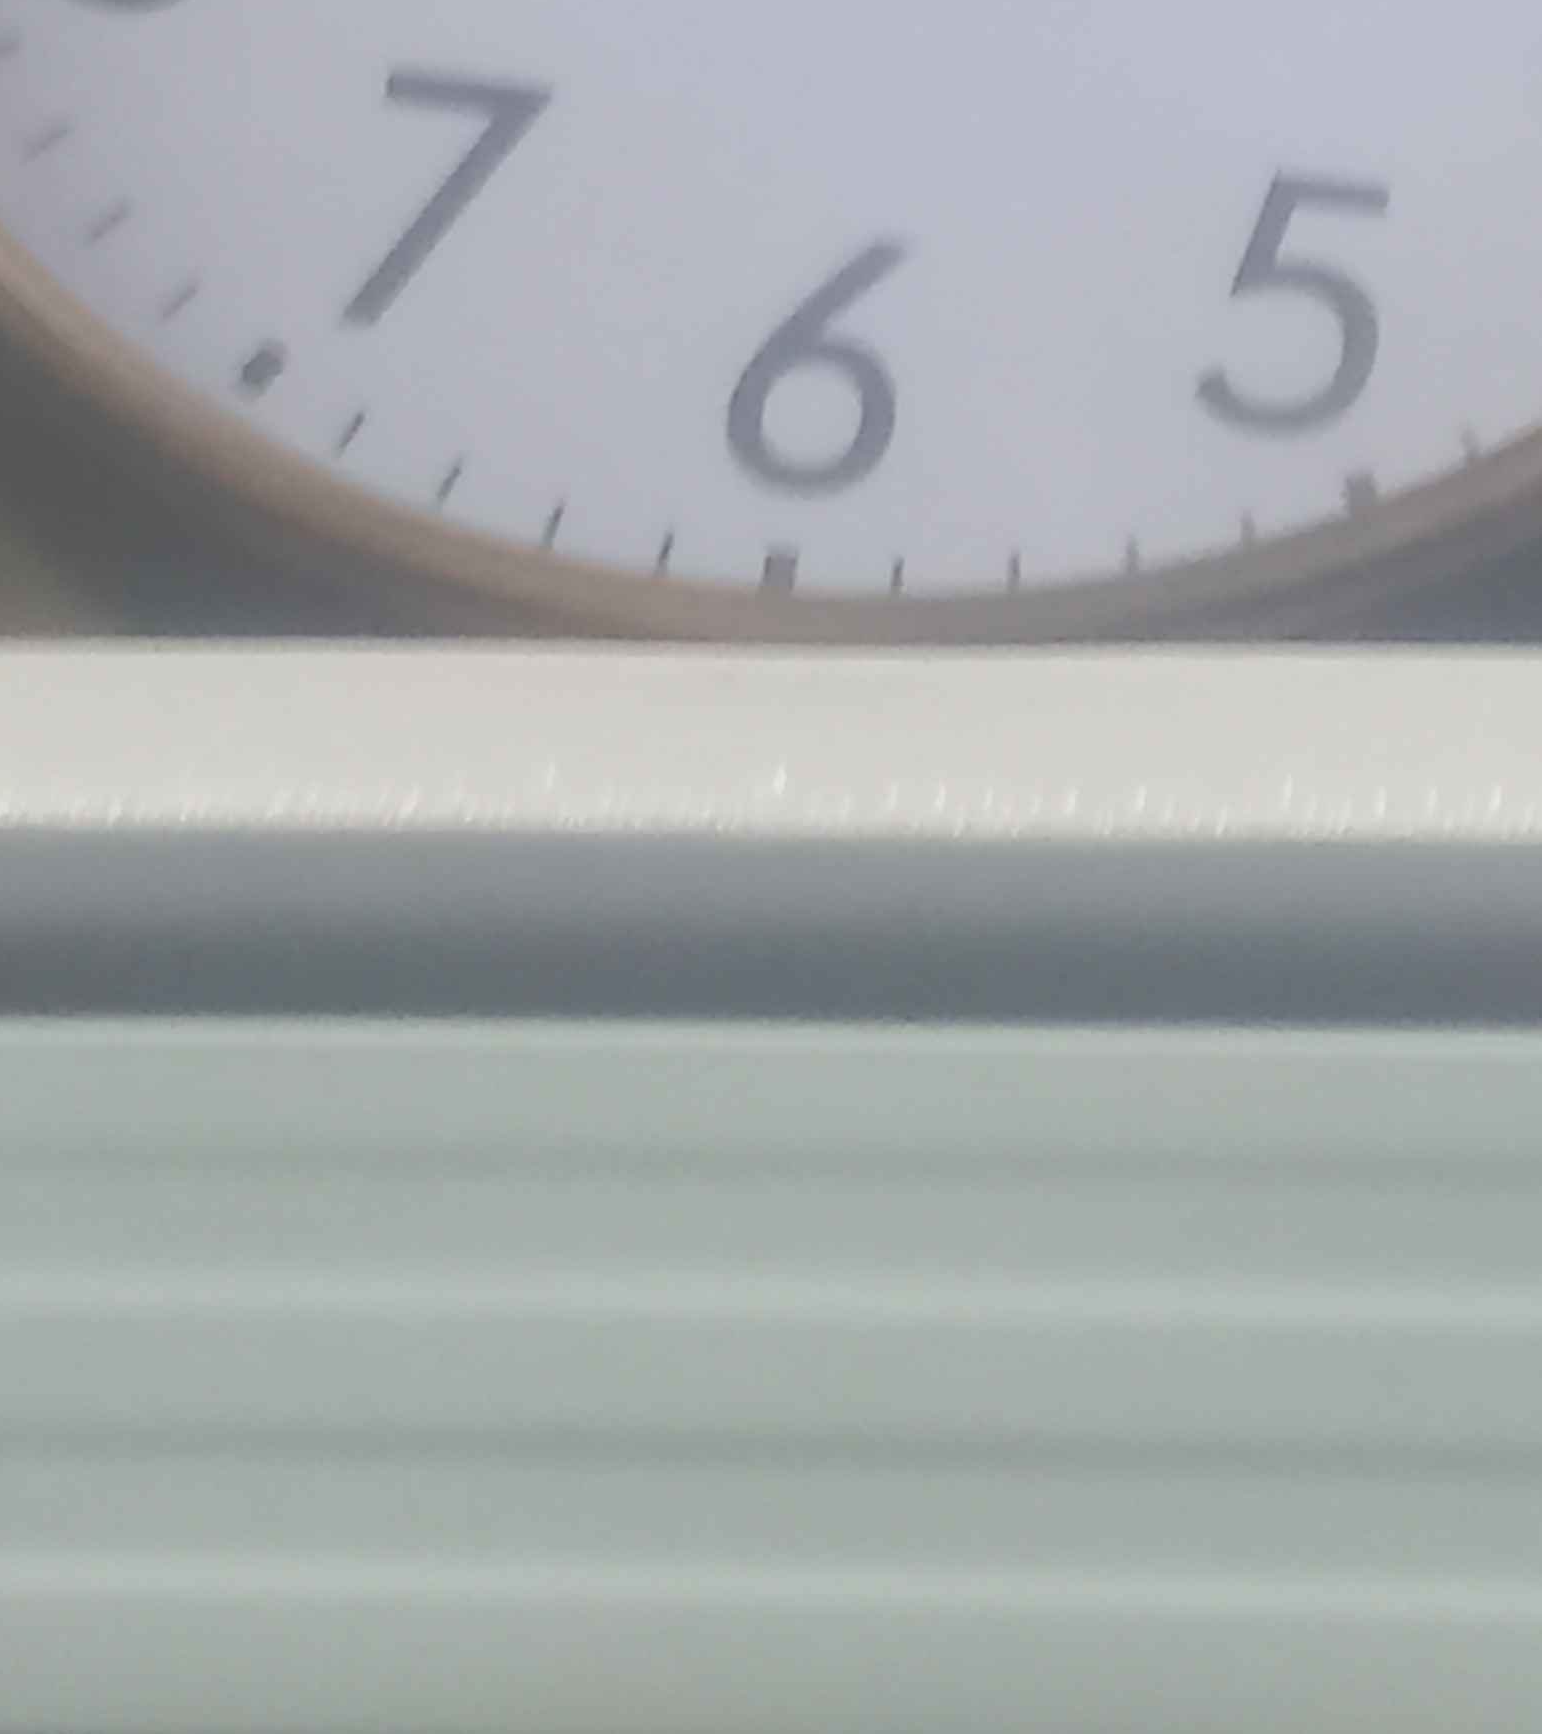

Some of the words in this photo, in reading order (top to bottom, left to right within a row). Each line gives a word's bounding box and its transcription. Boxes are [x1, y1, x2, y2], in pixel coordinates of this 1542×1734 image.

[341, 66, 553, 329] 7
[1194, 168, 1390, 438] 5
[726, 234, 907, 501] 6
